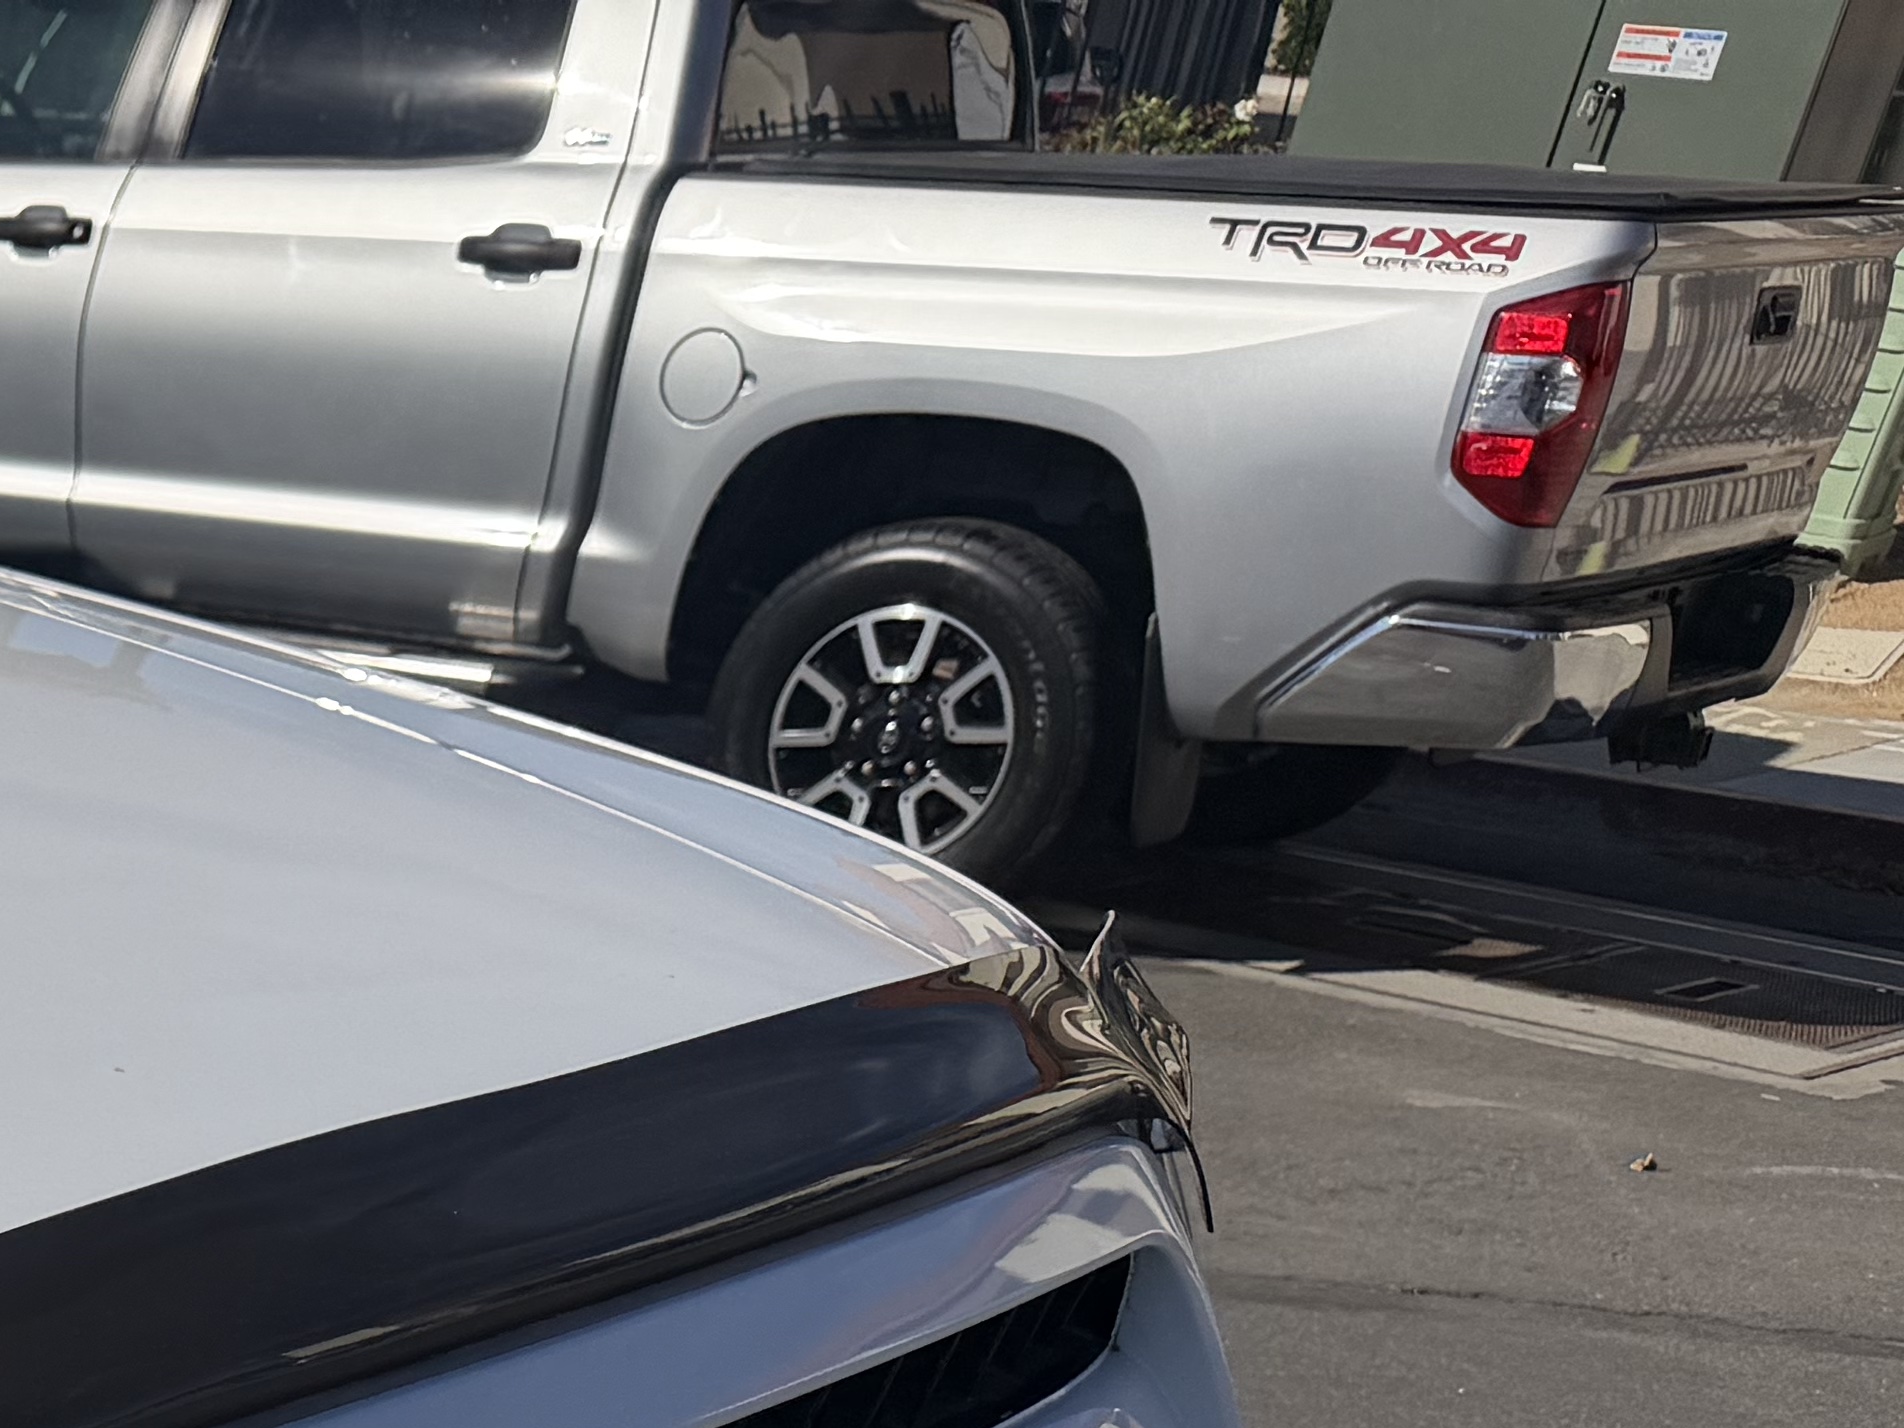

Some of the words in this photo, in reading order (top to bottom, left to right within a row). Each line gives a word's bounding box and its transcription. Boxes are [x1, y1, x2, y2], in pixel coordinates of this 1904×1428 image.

[1209, 216, 1368, 264] TRD
[1363, 256, 1422, 271] OFF
[1425, 259, 1510, 277] ROAD
